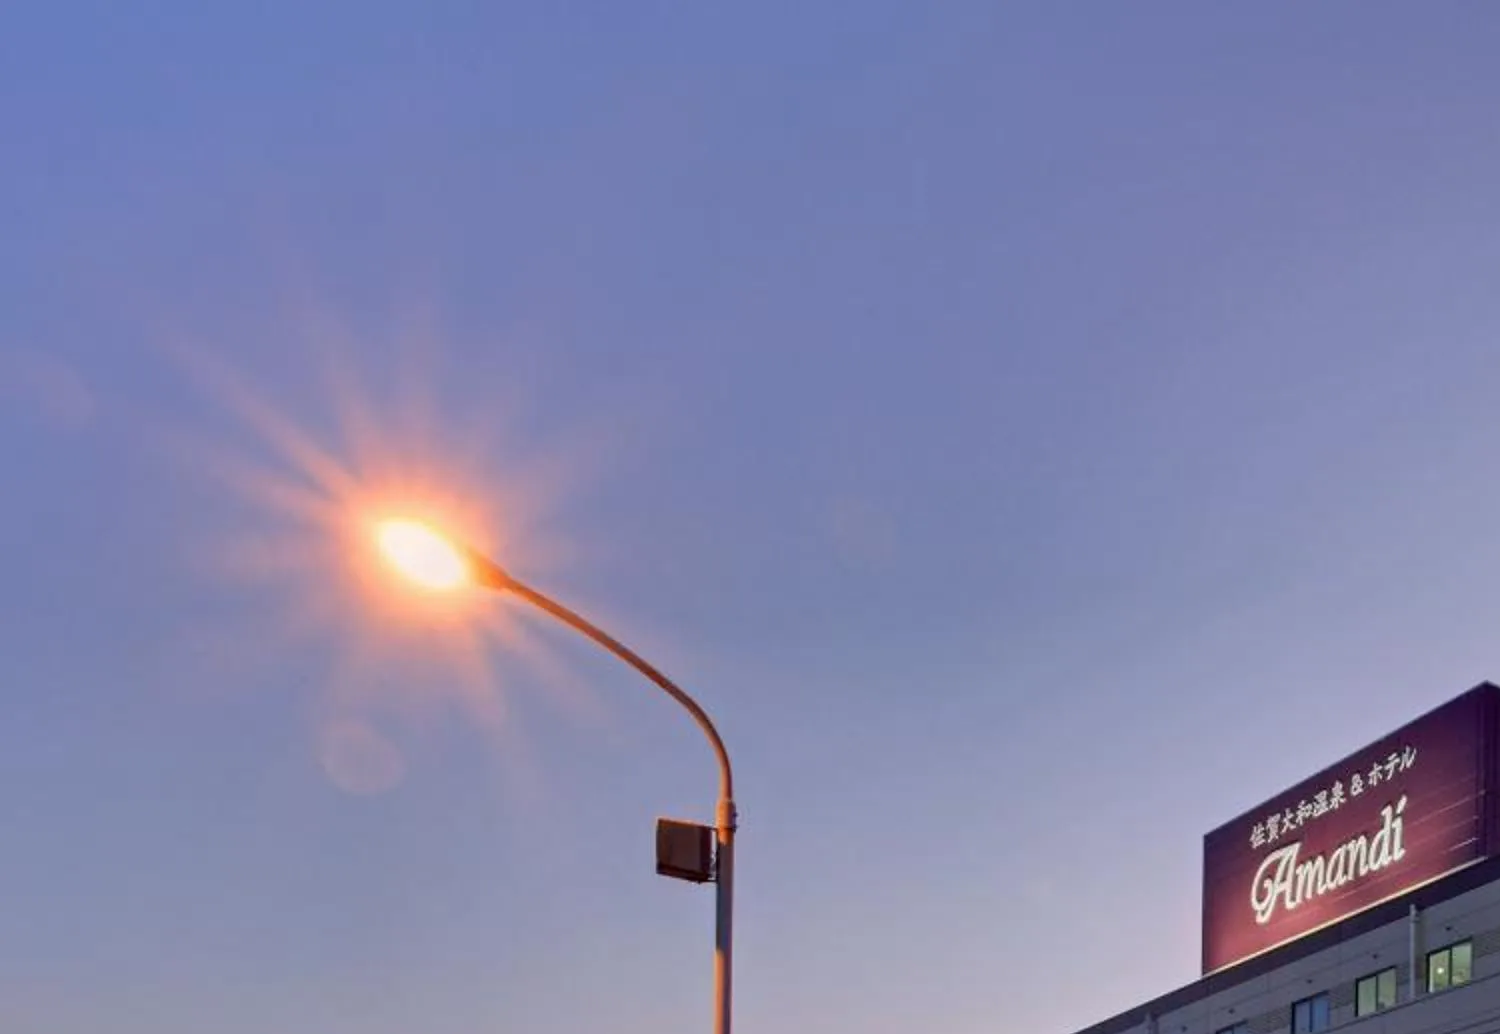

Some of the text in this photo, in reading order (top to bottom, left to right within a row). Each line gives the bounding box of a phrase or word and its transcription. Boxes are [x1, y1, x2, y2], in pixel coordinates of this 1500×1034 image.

[1249, 745, 1417, 849] 佐賀大和温泉 & ホテル
